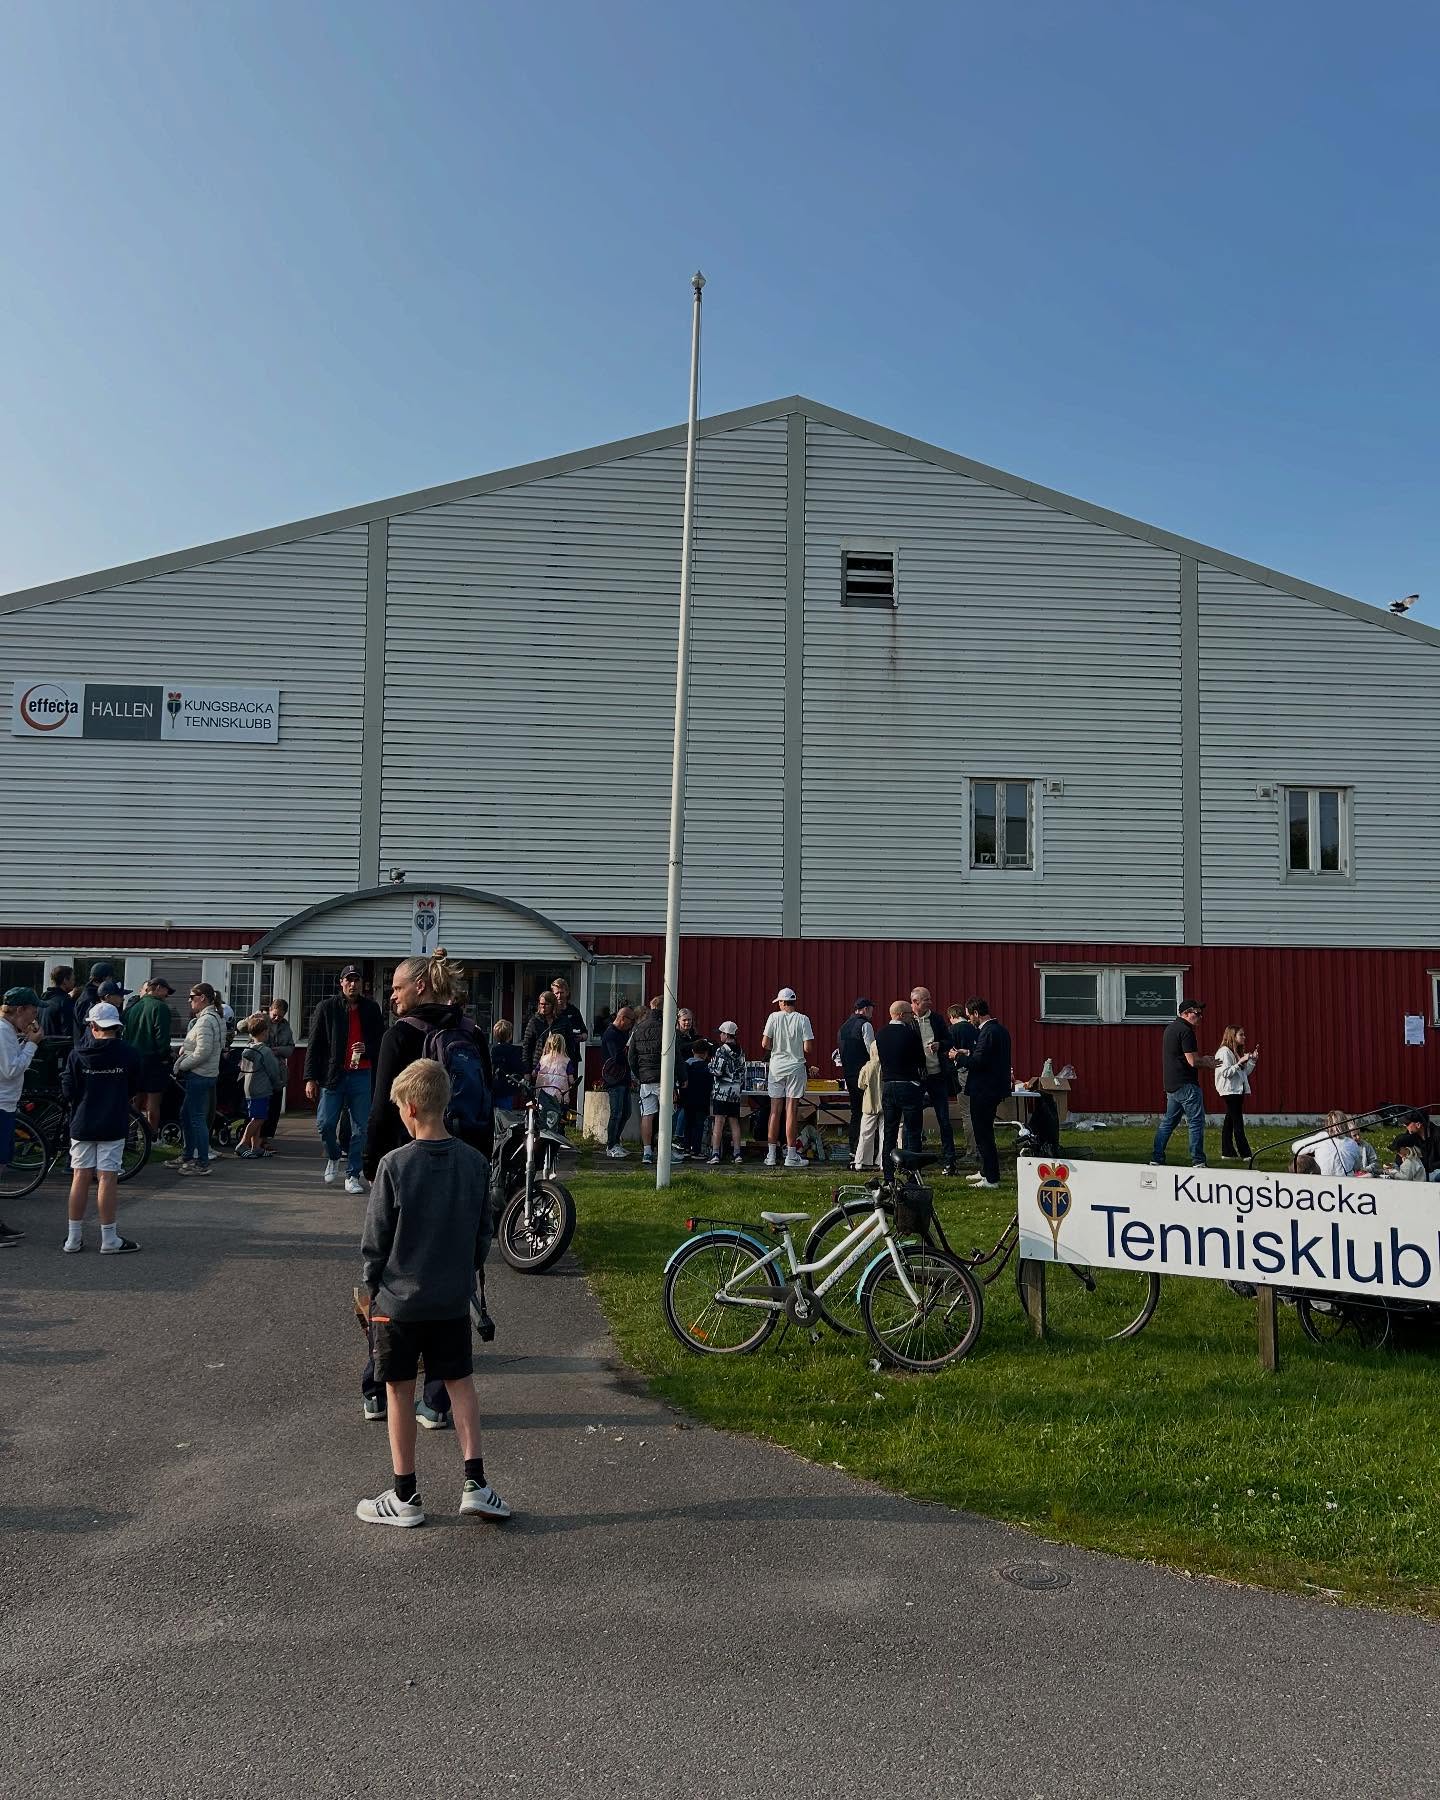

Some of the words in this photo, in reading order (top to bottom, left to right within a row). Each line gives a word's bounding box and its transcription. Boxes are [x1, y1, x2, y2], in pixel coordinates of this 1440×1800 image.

[28, 698, 79, 714] effecta
[91, 701, 154, 718] HALLEN
[184, 699, 275, 714] KUNGSBACKA
[184, 716, 272, 729] TENNISKLUBB
[1174, 1173, 1378, 1215] Kungsbacka
[1090, 1204, 1440, 1289] Tennisklub
